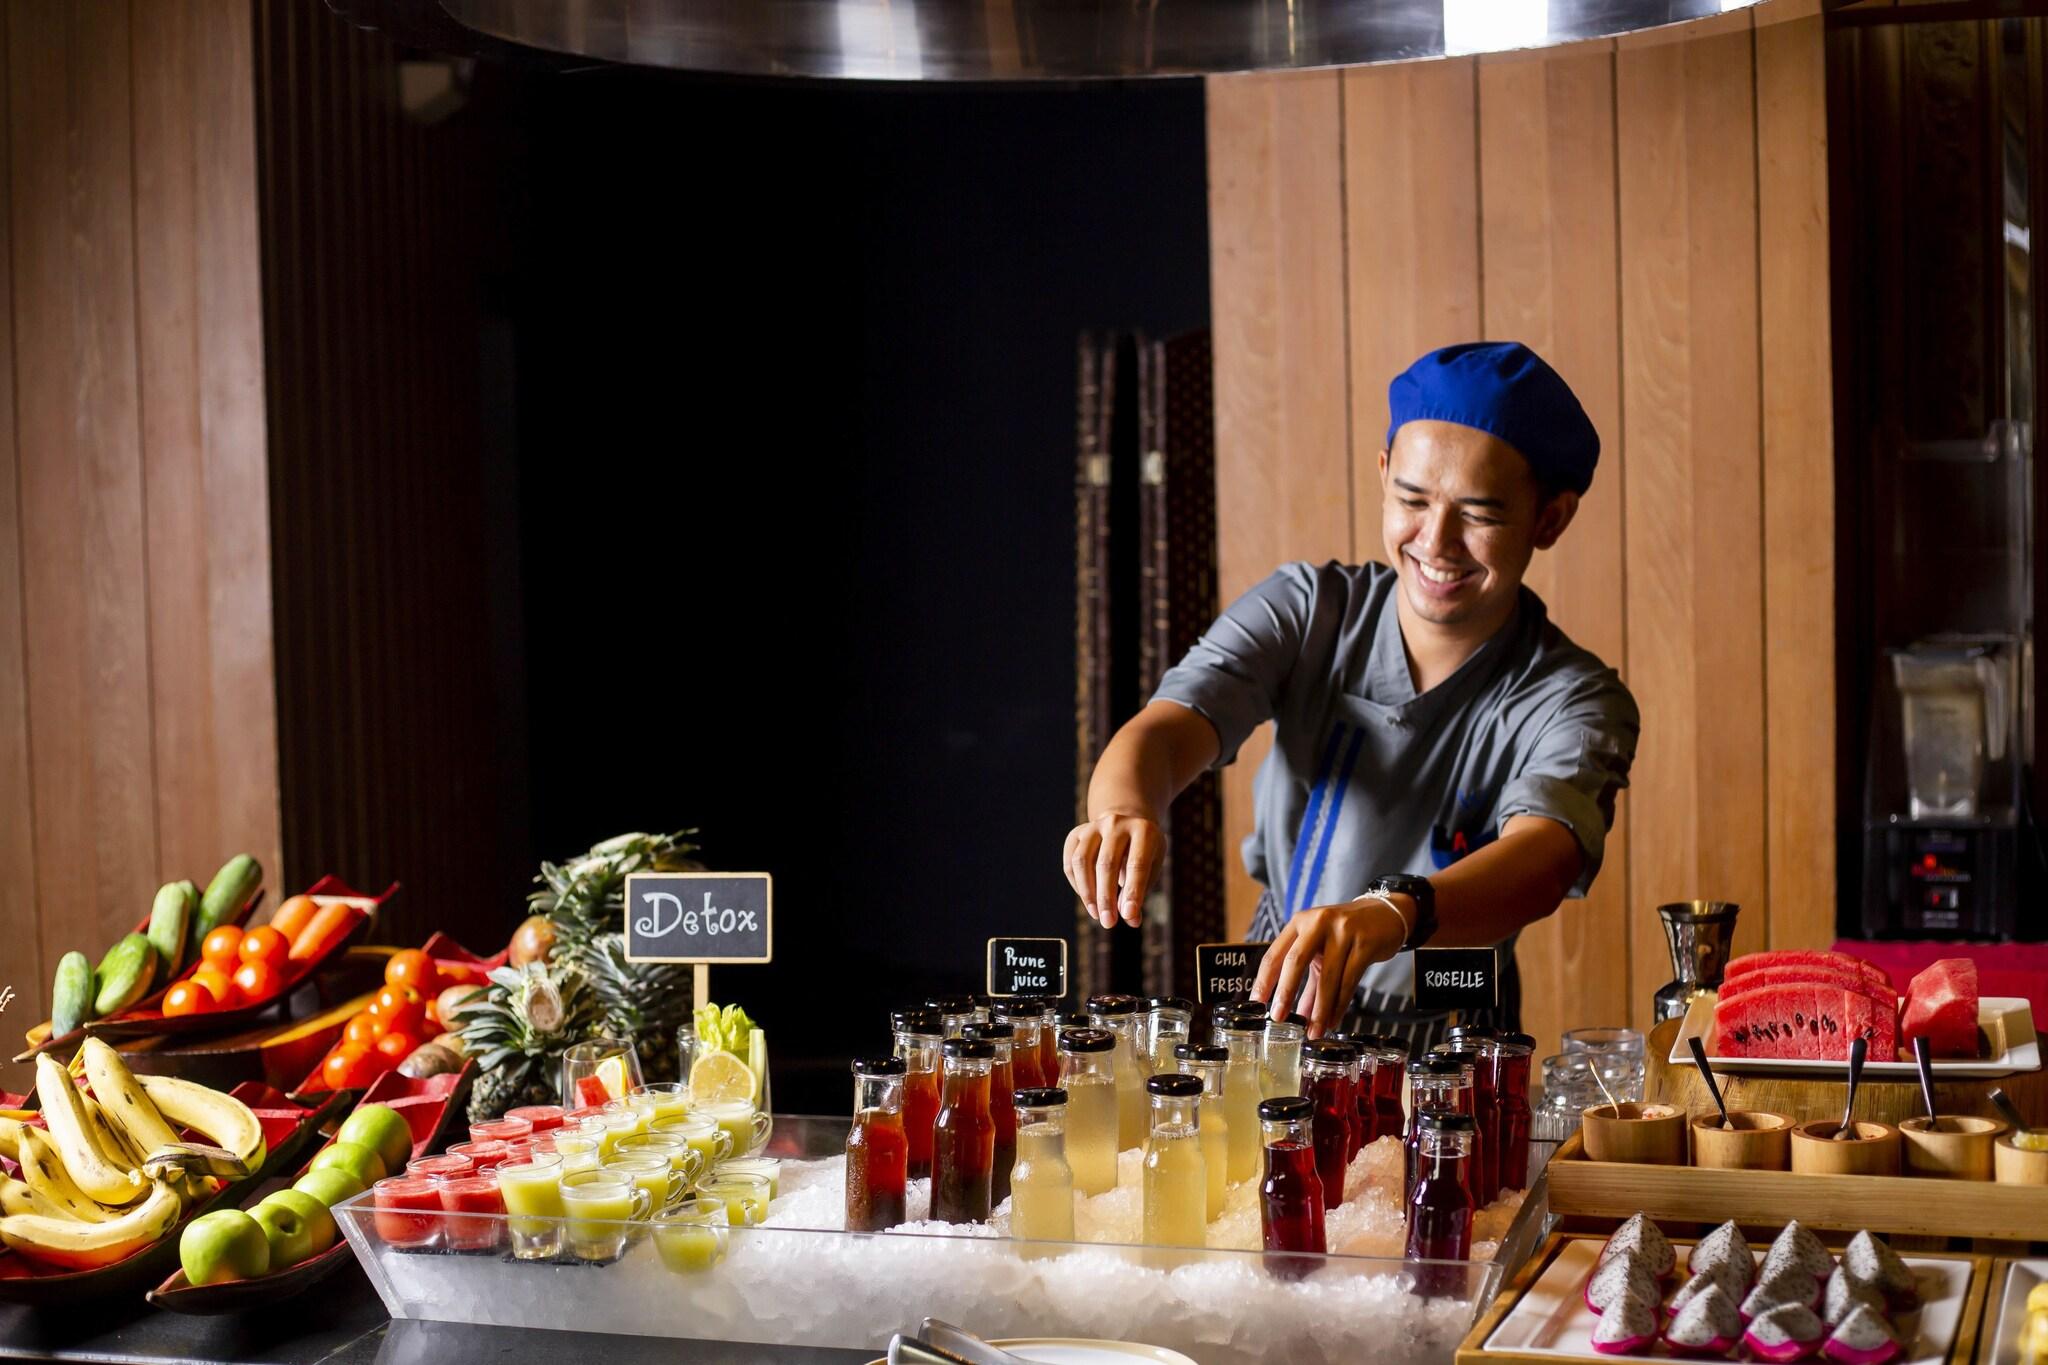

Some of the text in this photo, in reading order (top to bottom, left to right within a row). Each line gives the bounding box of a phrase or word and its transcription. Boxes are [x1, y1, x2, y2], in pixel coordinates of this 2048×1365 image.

[635, 891, 759, 939] Detox
[1004, 946, 1047, 968] Prune
[1215, 952, 1247, 966] CHIA
[1011, 971, 1049, 992] juice
[1210, 977, 1256, 993] FRESC
[1425, 970, 1485, 989] ROSELLE
